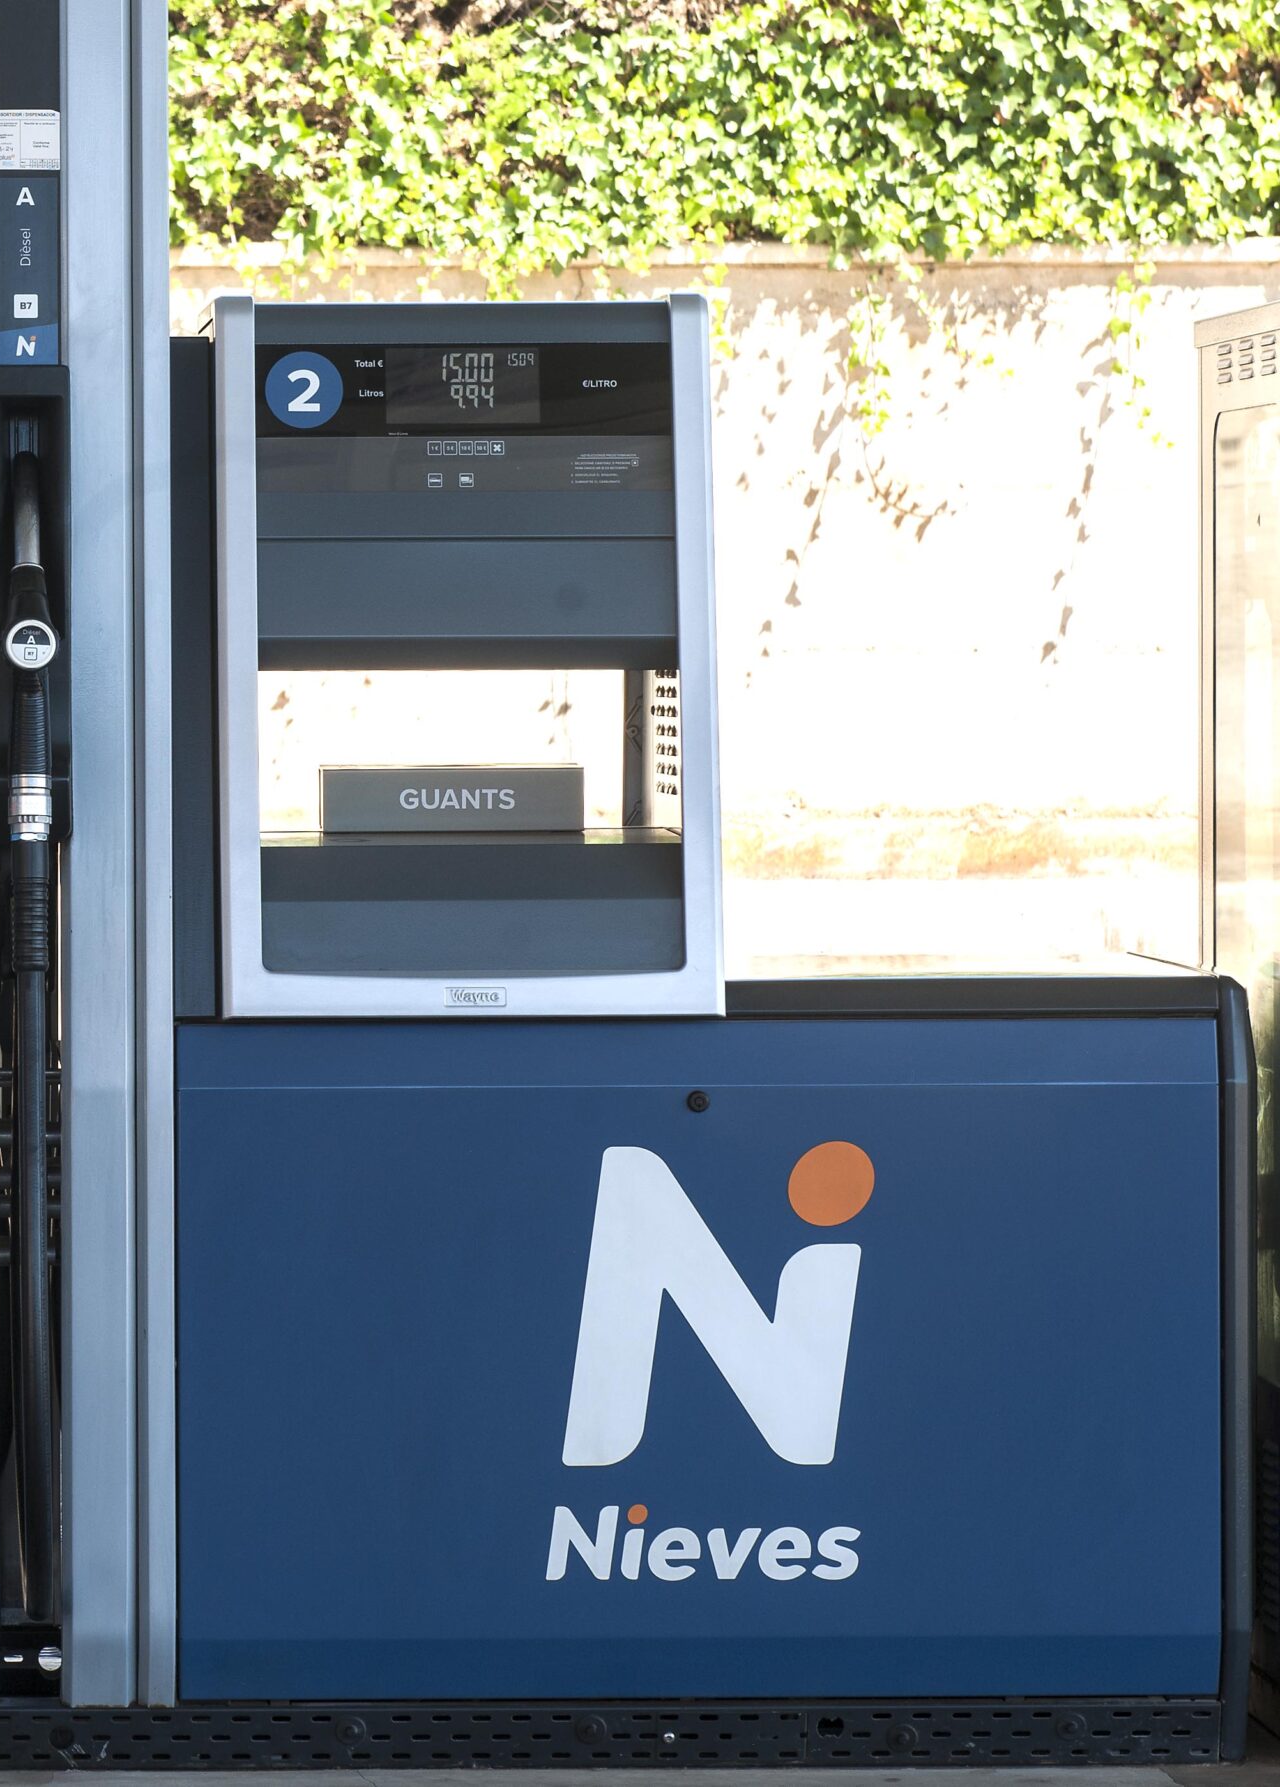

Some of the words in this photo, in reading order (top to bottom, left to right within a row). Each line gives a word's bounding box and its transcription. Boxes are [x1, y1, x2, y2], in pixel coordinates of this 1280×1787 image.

[16, 187, 35, 206] A
[20, 228, 31, 266] Dièsel
[20, 302, 32, 310] B7
[354, 359, 376, 368] Total
[377, 360, 384, 368] €
[442, 353, 494, 383] 15.00
[287, 369, 321, 413] 2
[359, 389, 384, 397] Litros
[582, 380, 618, 388] €/LITRO
[450, 385, 494, 409] 9.94
[27, 635, 36, 644] A
[399, 788, 516, 811] GUANTS
[450, 989, 499, 1005] Wayne
[545, 1503, 862, 1582] Nieves
